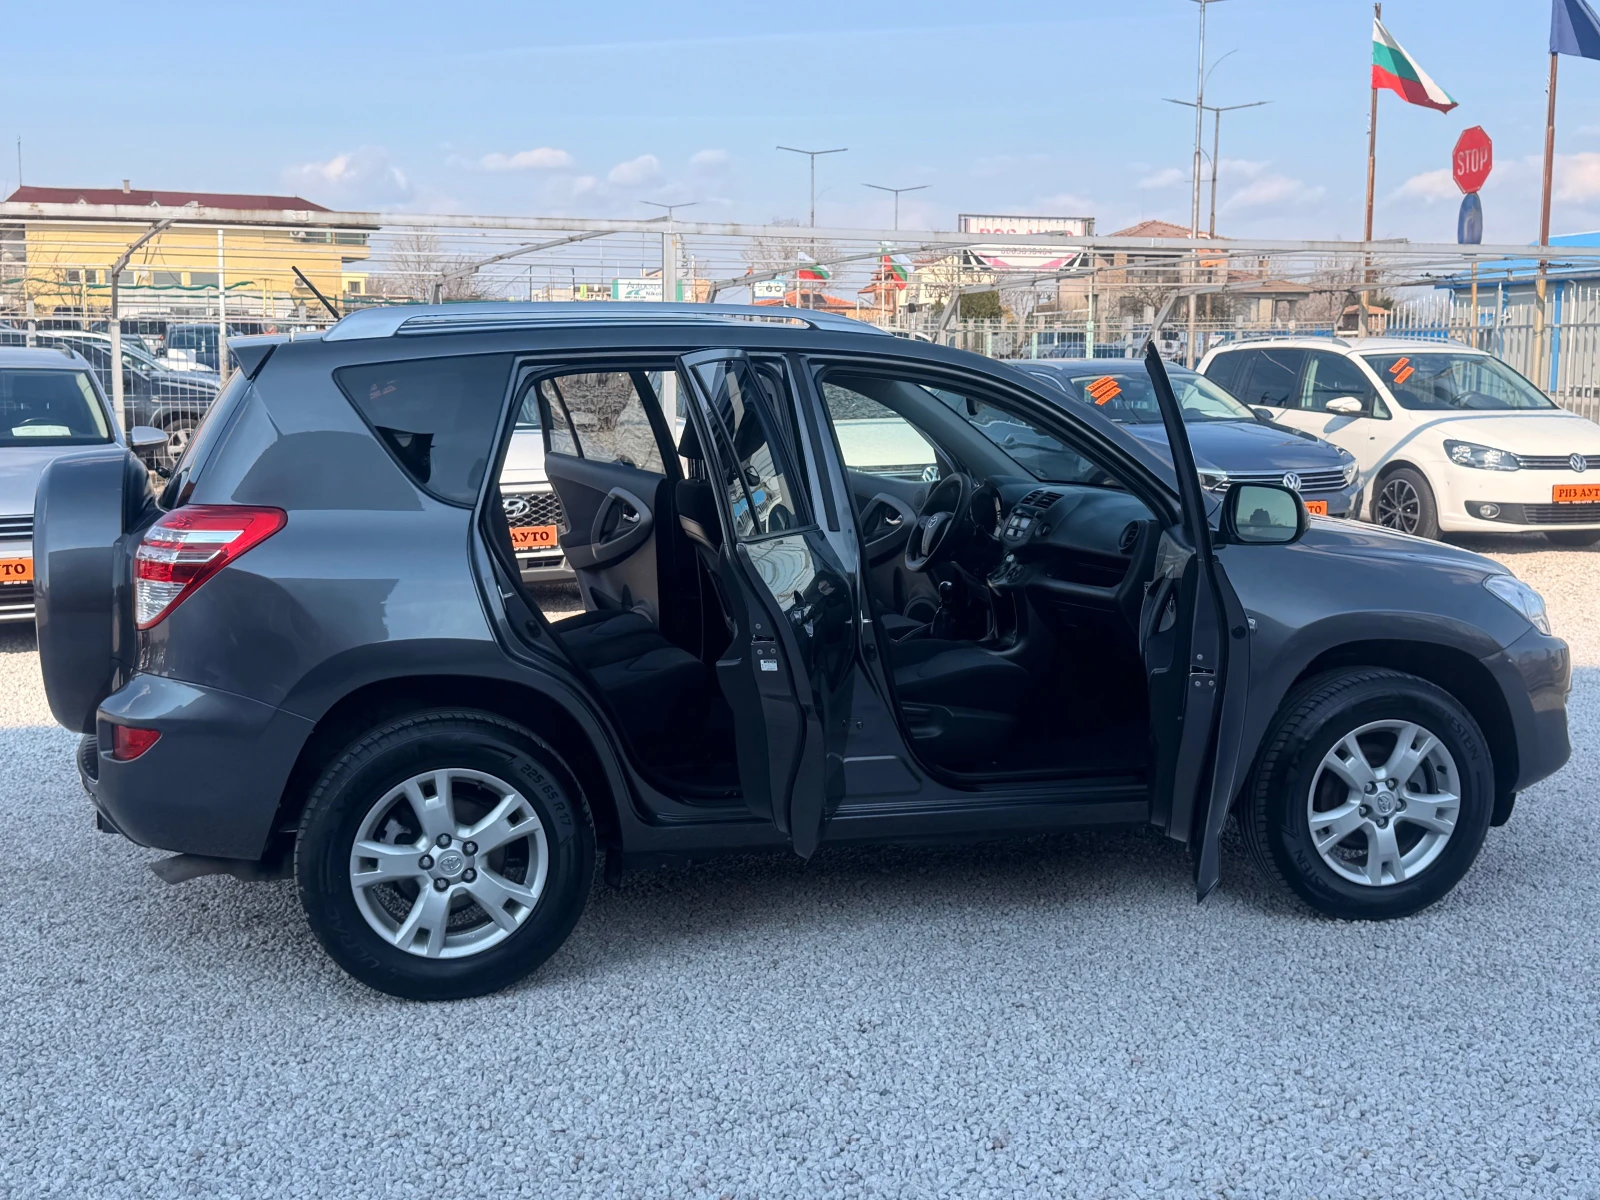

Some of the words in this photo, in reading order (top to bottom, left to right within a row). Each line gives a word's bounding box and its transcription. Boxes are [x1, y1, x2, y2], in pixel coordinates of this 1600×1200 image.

[1457, 147, 1488, 176] STOP
[511, 531, 550, 543] АУТО
[0, 563, 26, 575] ТО
[520, 763, 560, 800] 225/65
[552, 801, 566, 812] R
[559, 812, 573, 826] 17
